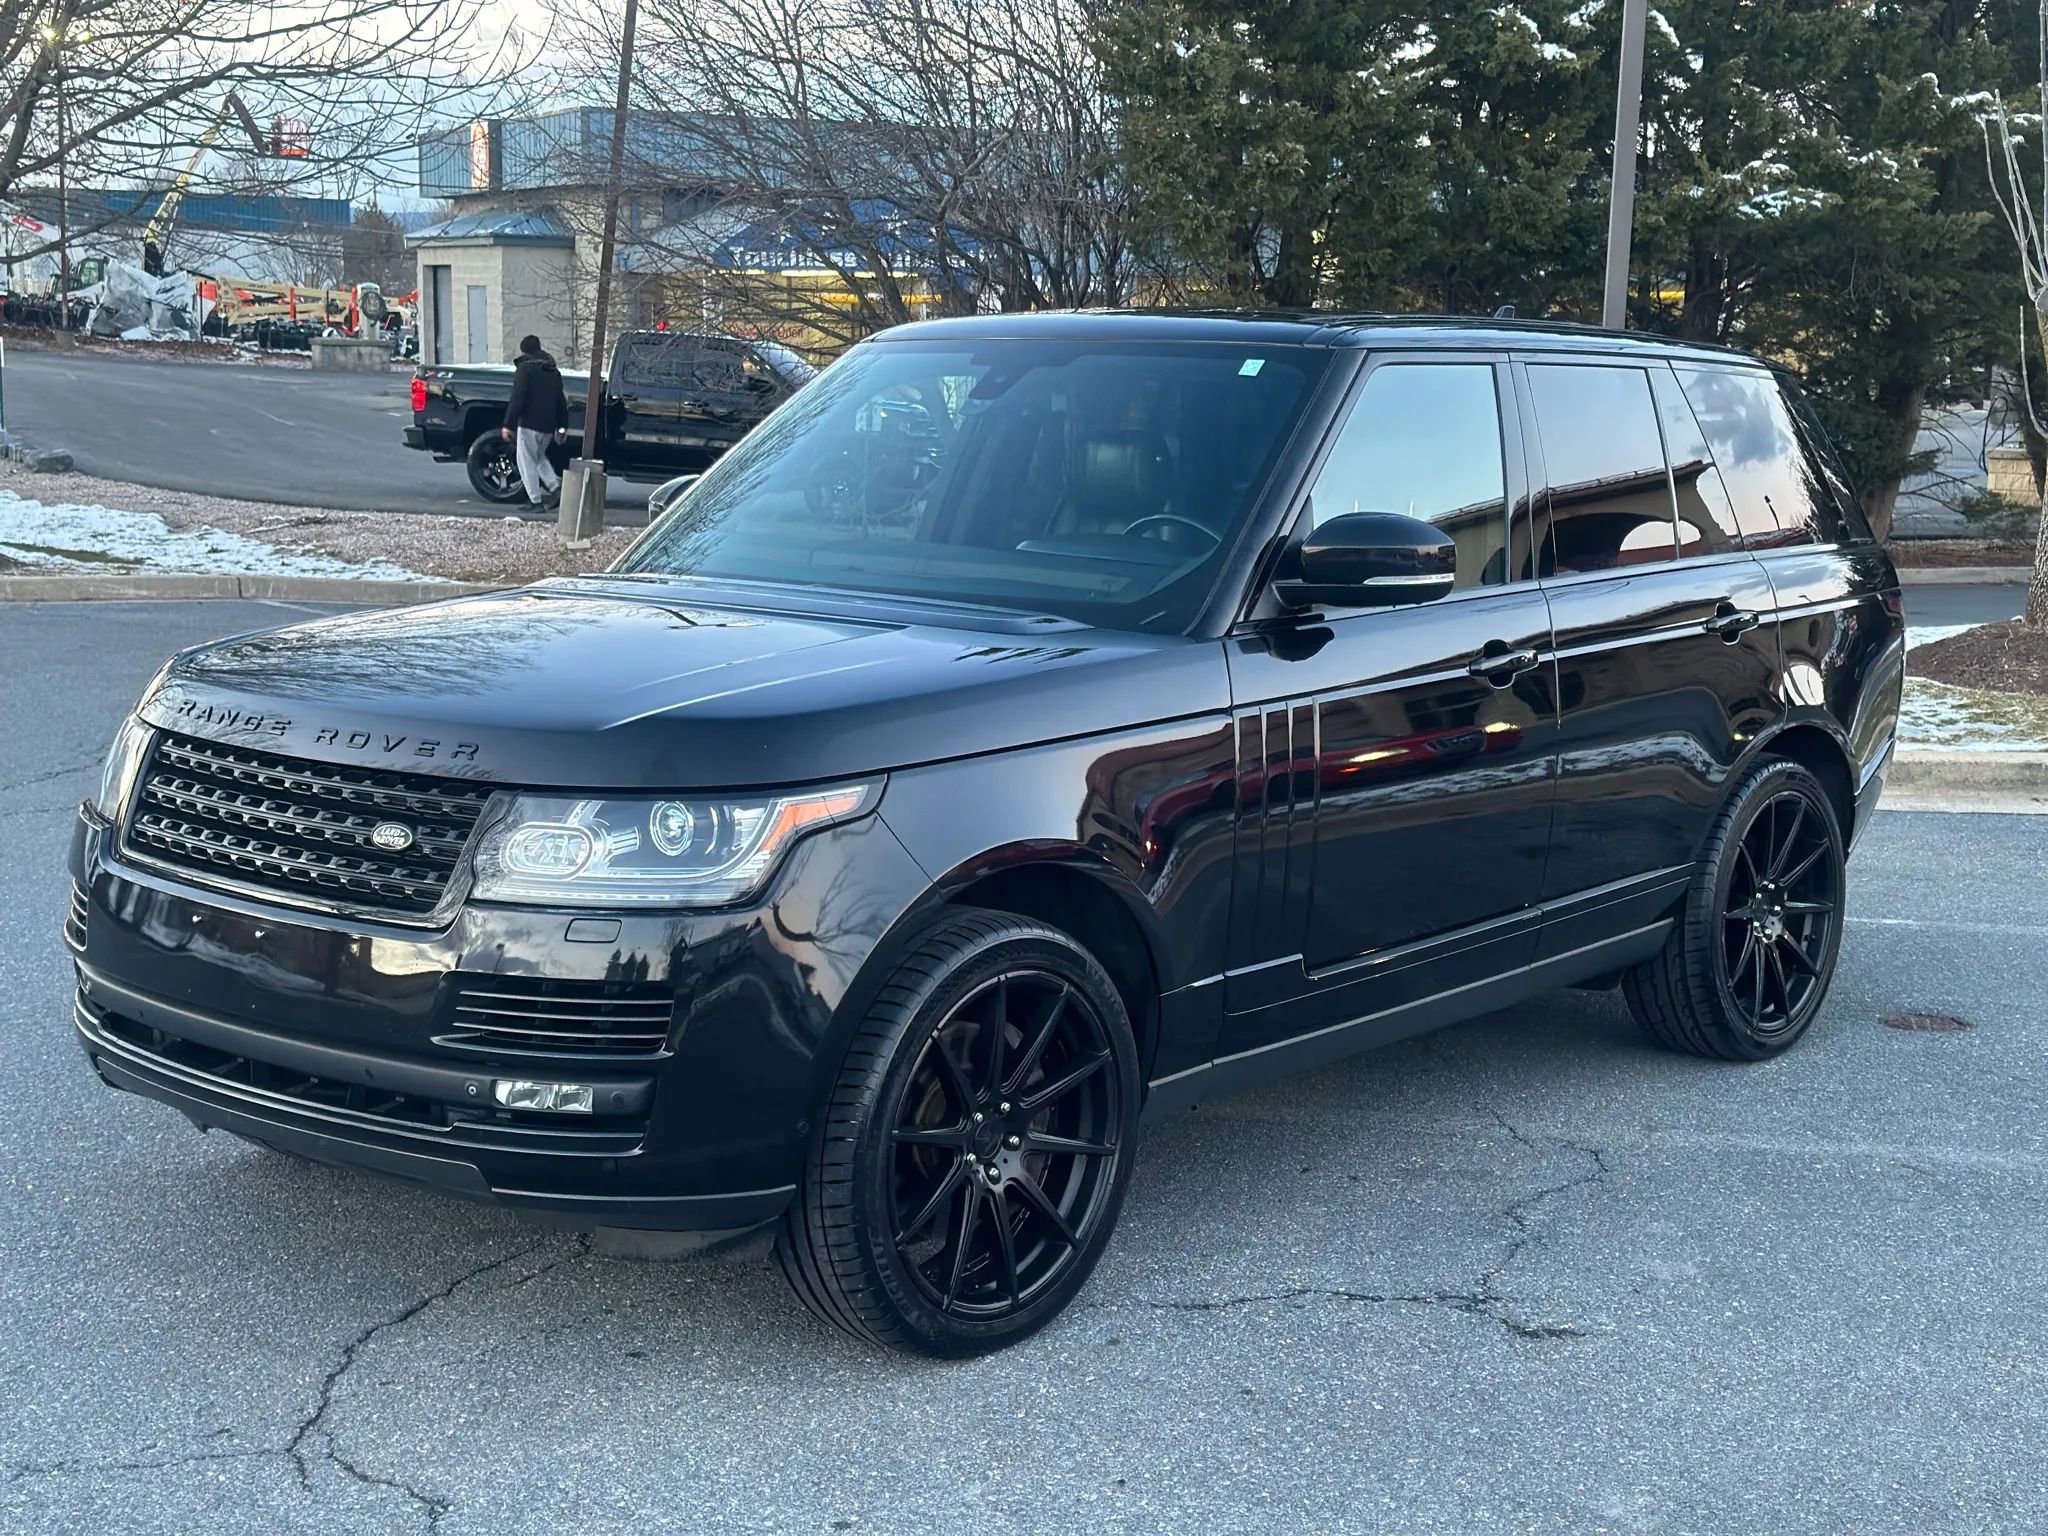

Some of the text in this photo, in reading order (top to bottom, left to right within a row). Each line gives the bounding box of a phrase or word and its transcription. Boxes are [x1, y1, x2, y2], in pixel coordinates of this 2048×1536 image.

[177, 699, 480, 761] RANGE ROVER
[380, 835, 406, 846] ROVER
